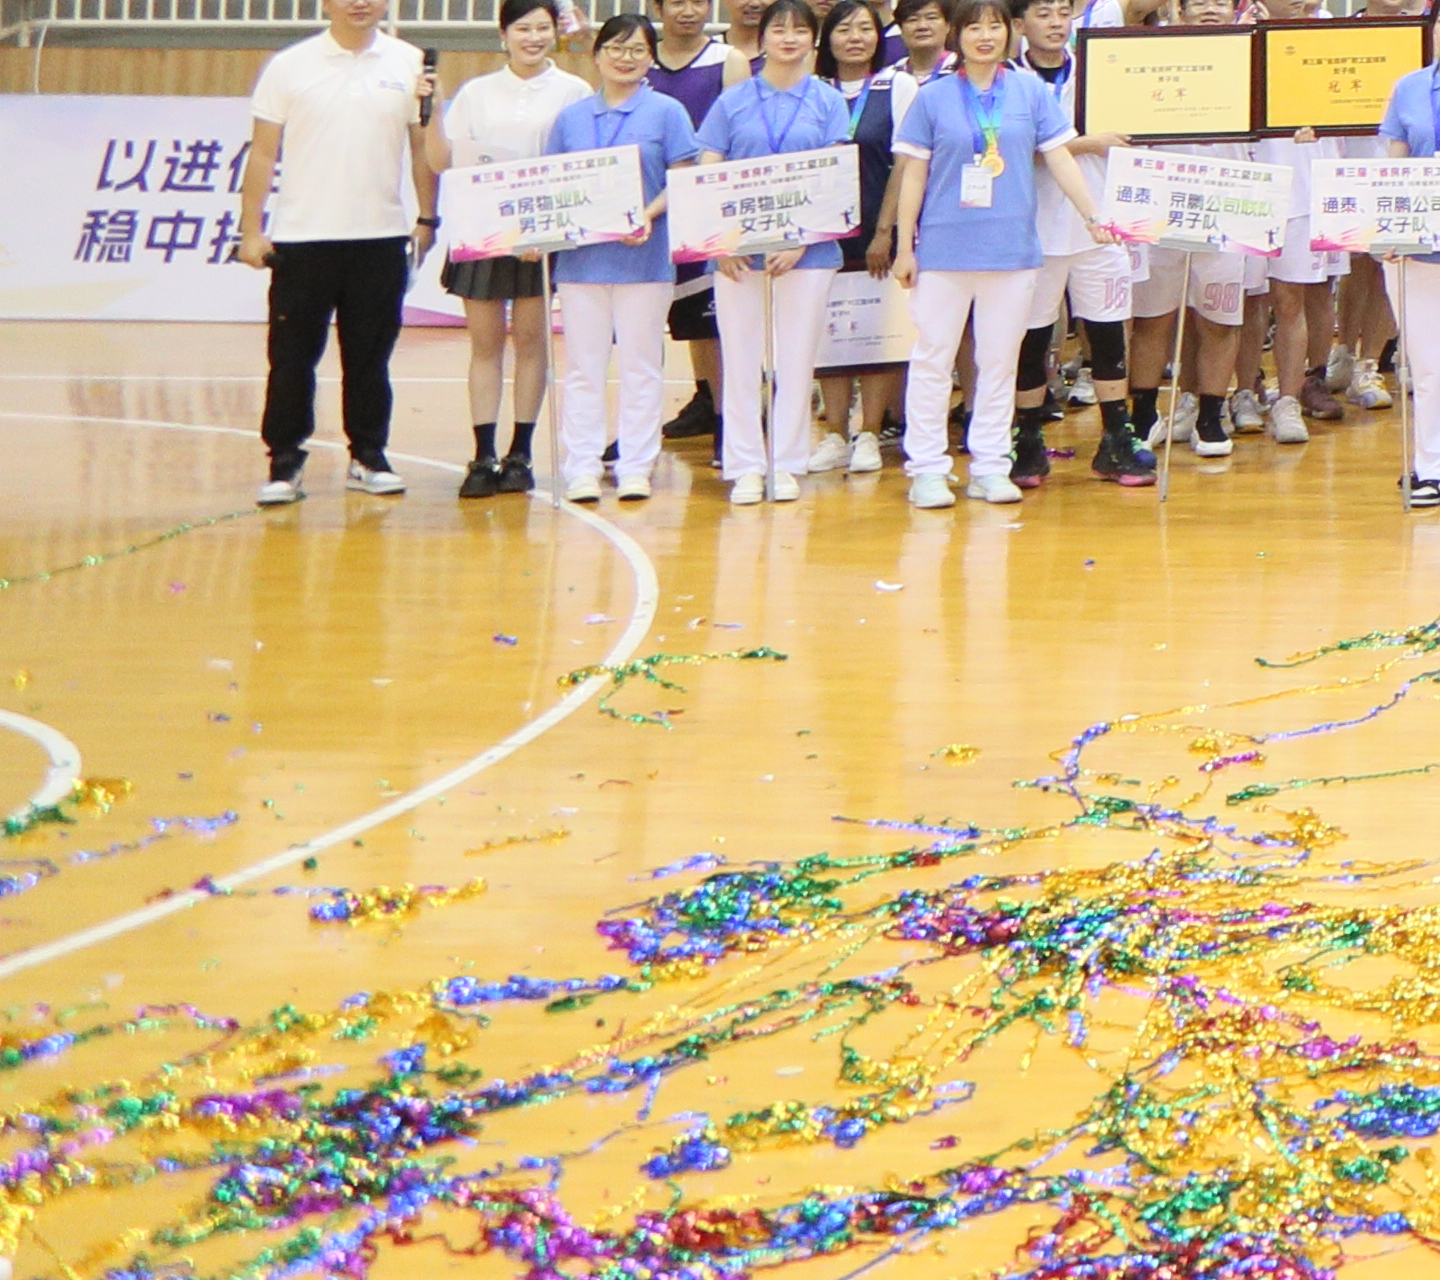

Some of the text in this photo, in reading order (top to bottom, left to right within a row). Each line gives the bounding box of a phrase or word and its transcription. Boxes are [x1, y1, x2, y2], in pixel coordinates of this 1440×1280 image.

[497, 188, 593, 217] 省房物业队
[719, 189, 813, 218] 省房物业队
[518, 213, 576, 234] 男子队
[739, 212, 795, 235] 女子队
[1166, 209, 1220, 231] 男子队
[1375, 215, 1429, 234] 女子队
[1203, 281, 1239, 315] 98
